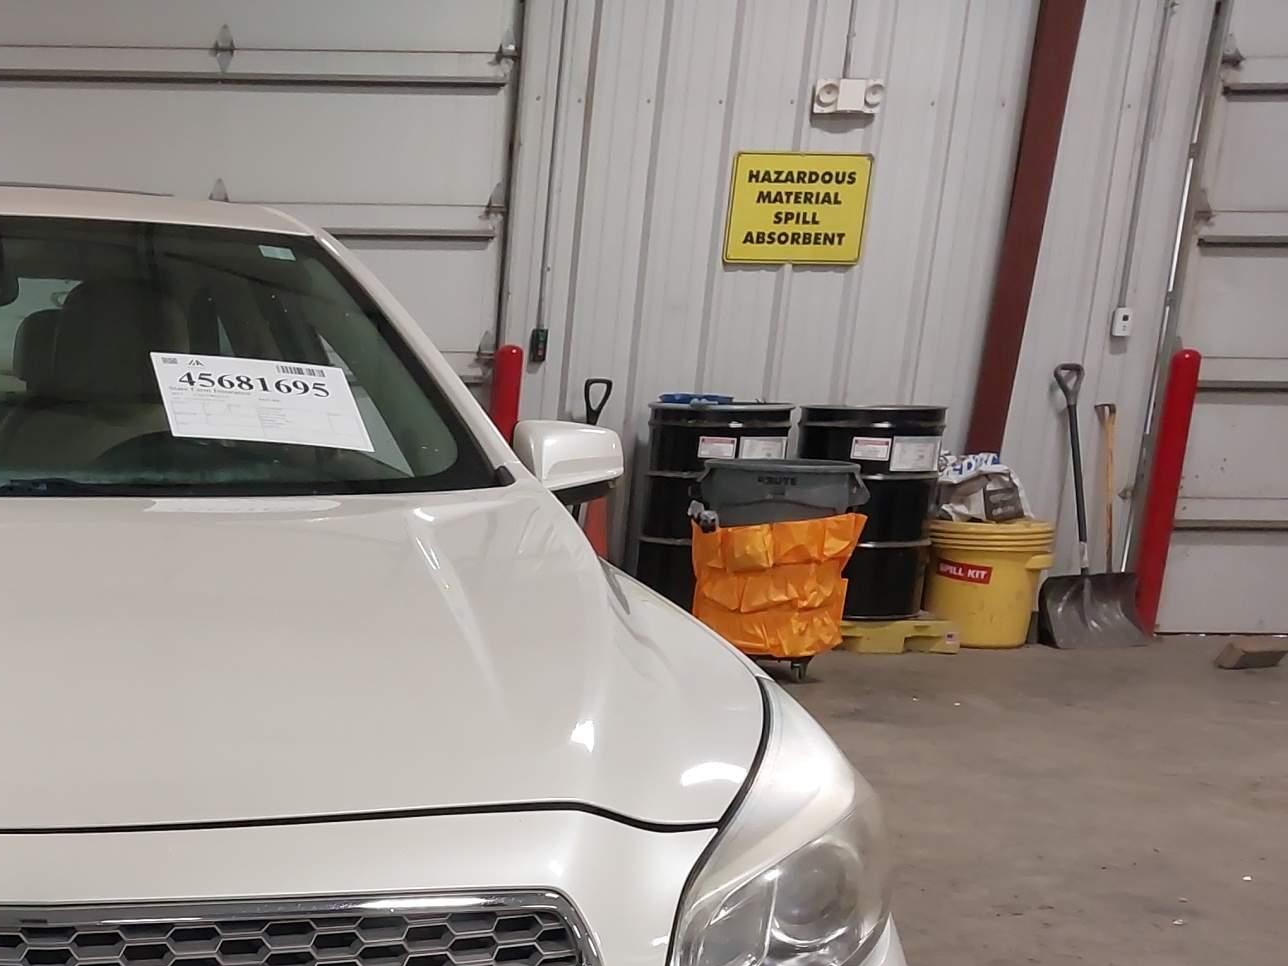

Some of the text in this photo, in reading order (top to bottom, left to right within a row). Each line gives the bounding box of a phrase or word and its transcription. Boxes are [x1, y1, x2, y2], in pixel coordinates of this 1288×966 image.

[747, 169, 857, 185] HAZARDOUS
[755, 190, 842, 205] MATERIAL
[772, 211, 820, 225] SPILL
[742, 231, 846, 246] ABSORBENT
[178, 371, 330, 398] 45681695
[967, 568, 988, 580] KIT
